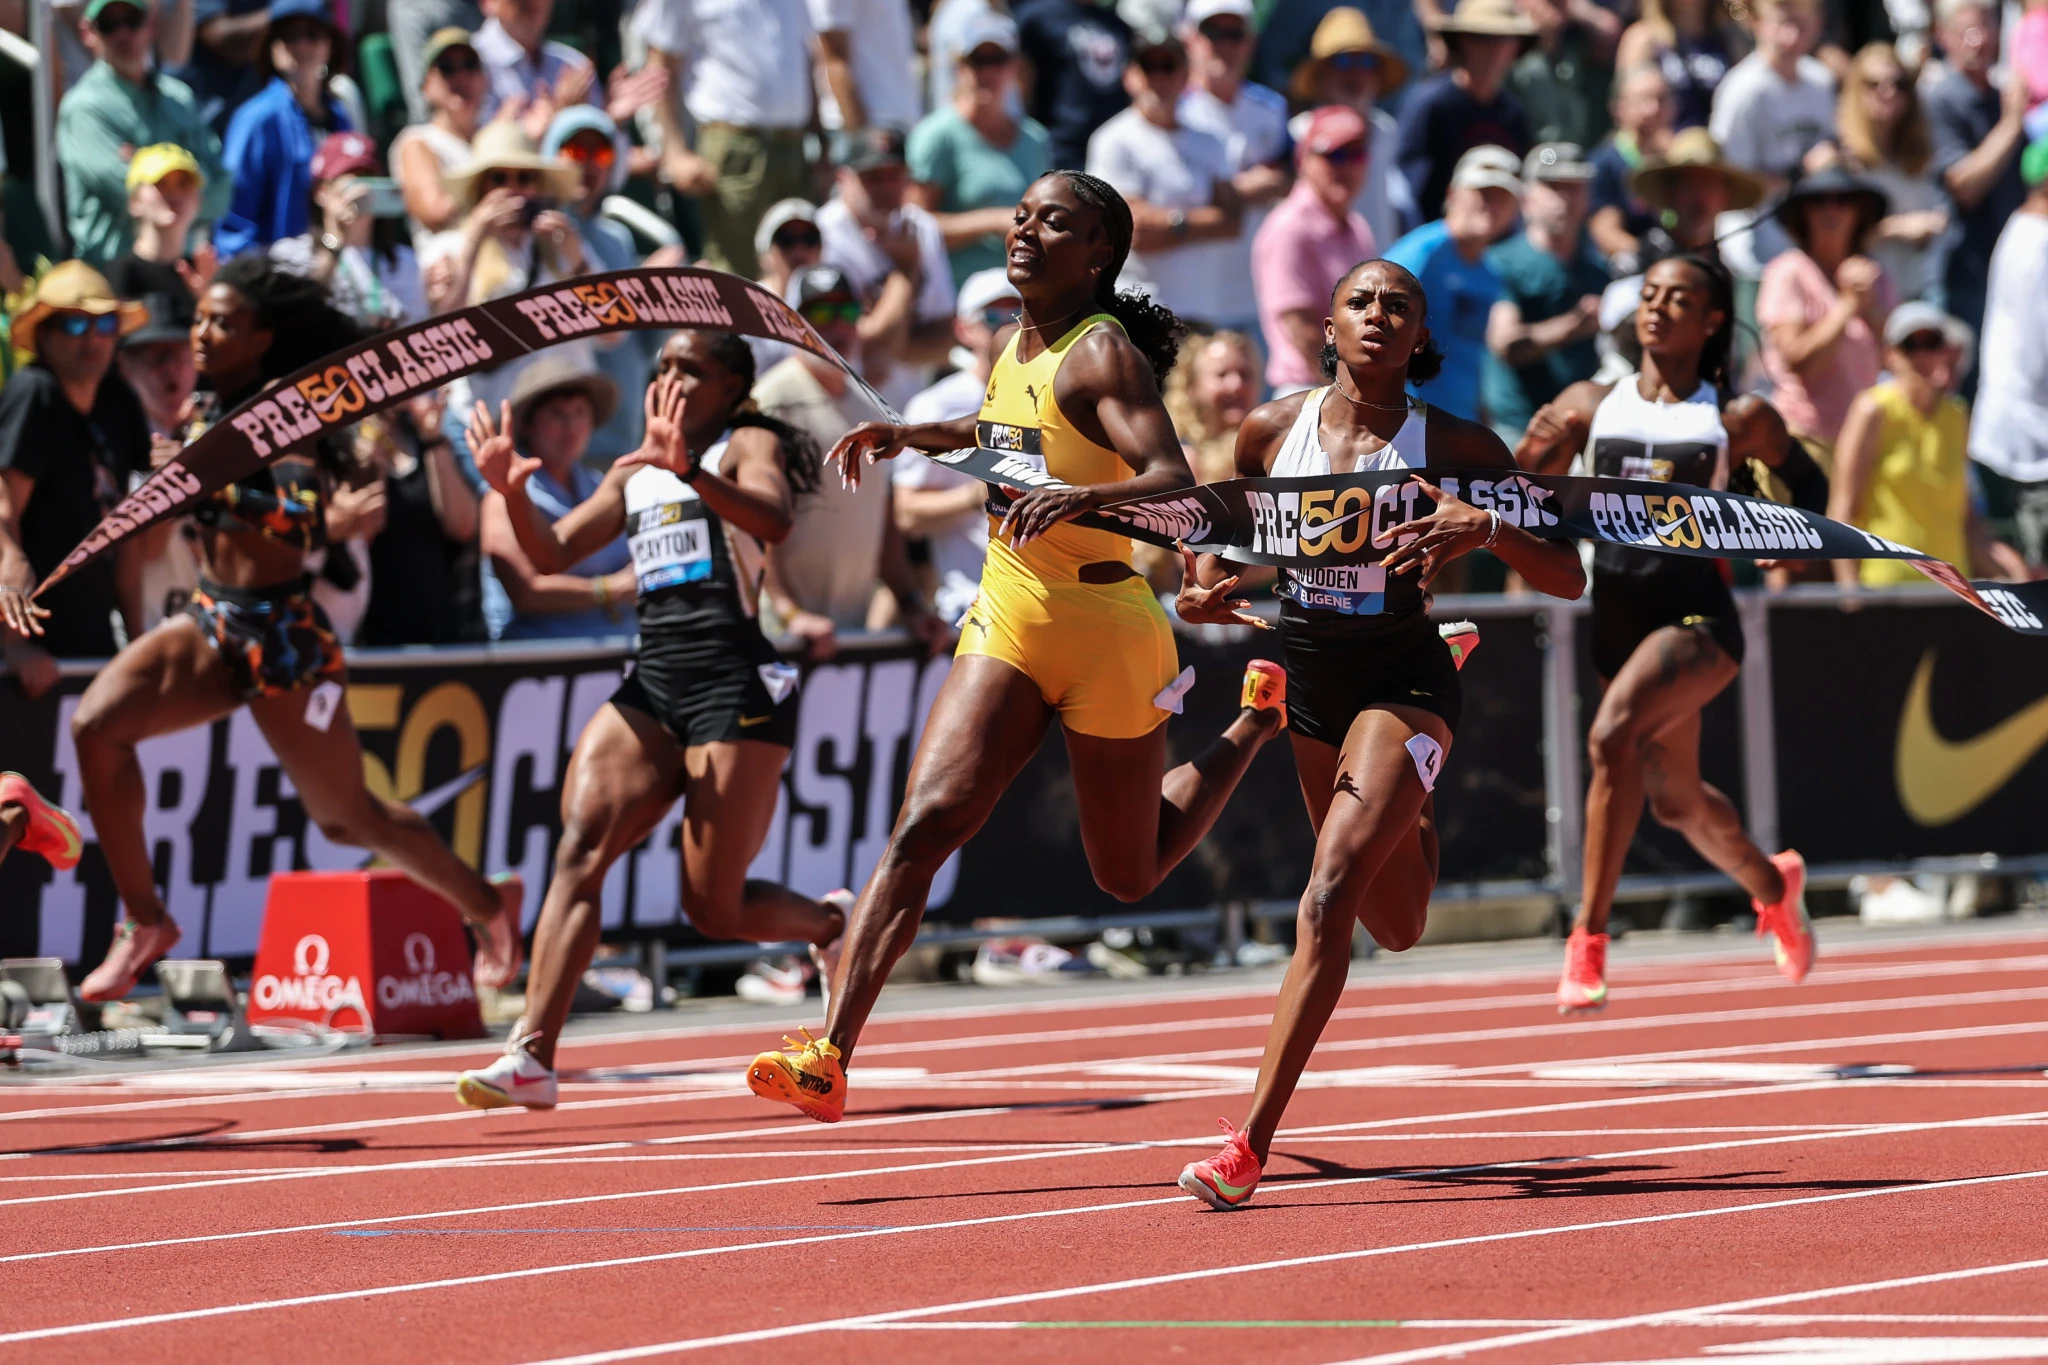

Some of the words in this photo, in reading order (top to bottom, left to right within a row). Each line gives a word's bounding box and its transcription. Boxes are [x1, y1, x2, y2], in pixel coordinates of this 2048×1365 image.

[1296, 567, 1358, 590] WOODEN
[1300, 588, 1352, 609] EUGENE
[1424, 748, 1437, 777] 4
[254, 974, 365, 1011] OMEGA
[377, 971, 475, 1010] OMEGA
